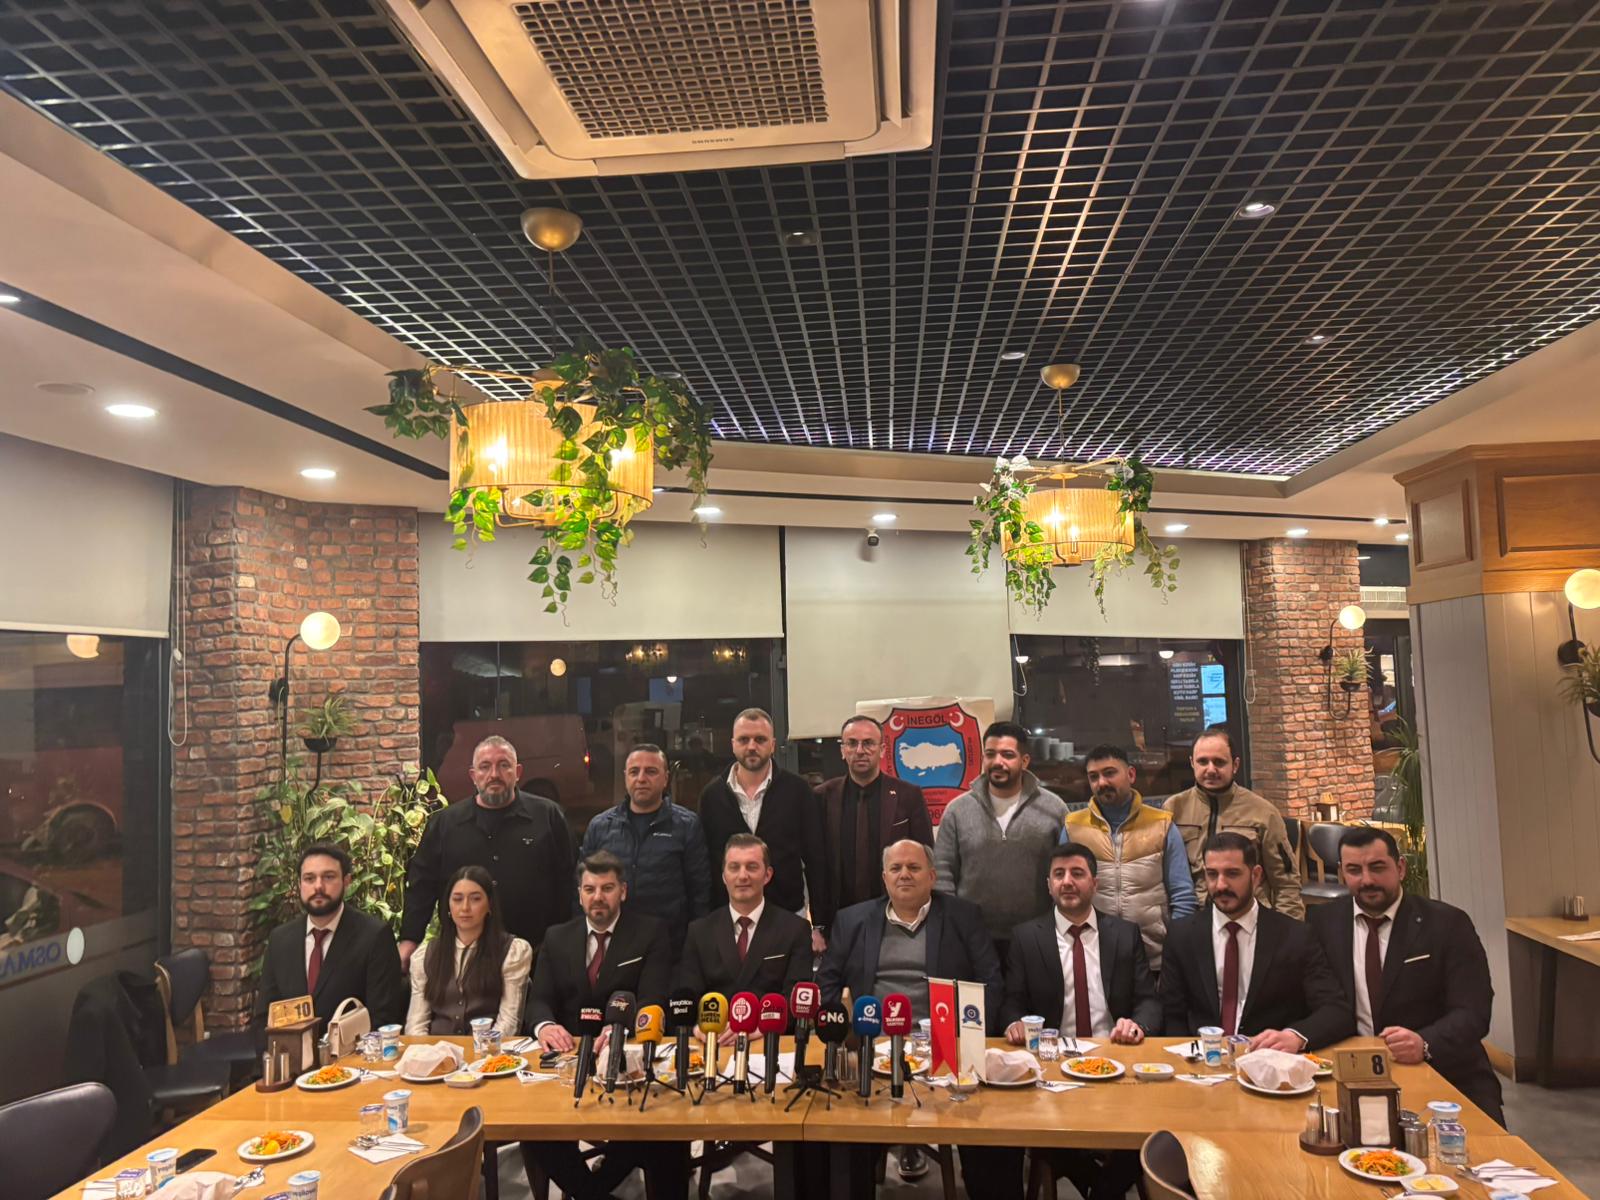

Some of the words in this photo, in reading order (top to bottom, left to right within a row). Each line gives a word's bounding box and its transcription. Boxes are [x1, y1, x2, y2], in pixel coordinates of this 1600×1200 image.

[907, 713, 947, 726] İNEGÖL
[294, 1001, 311, 1018] 10
[1371, 1054, 1384, 1075] 8
